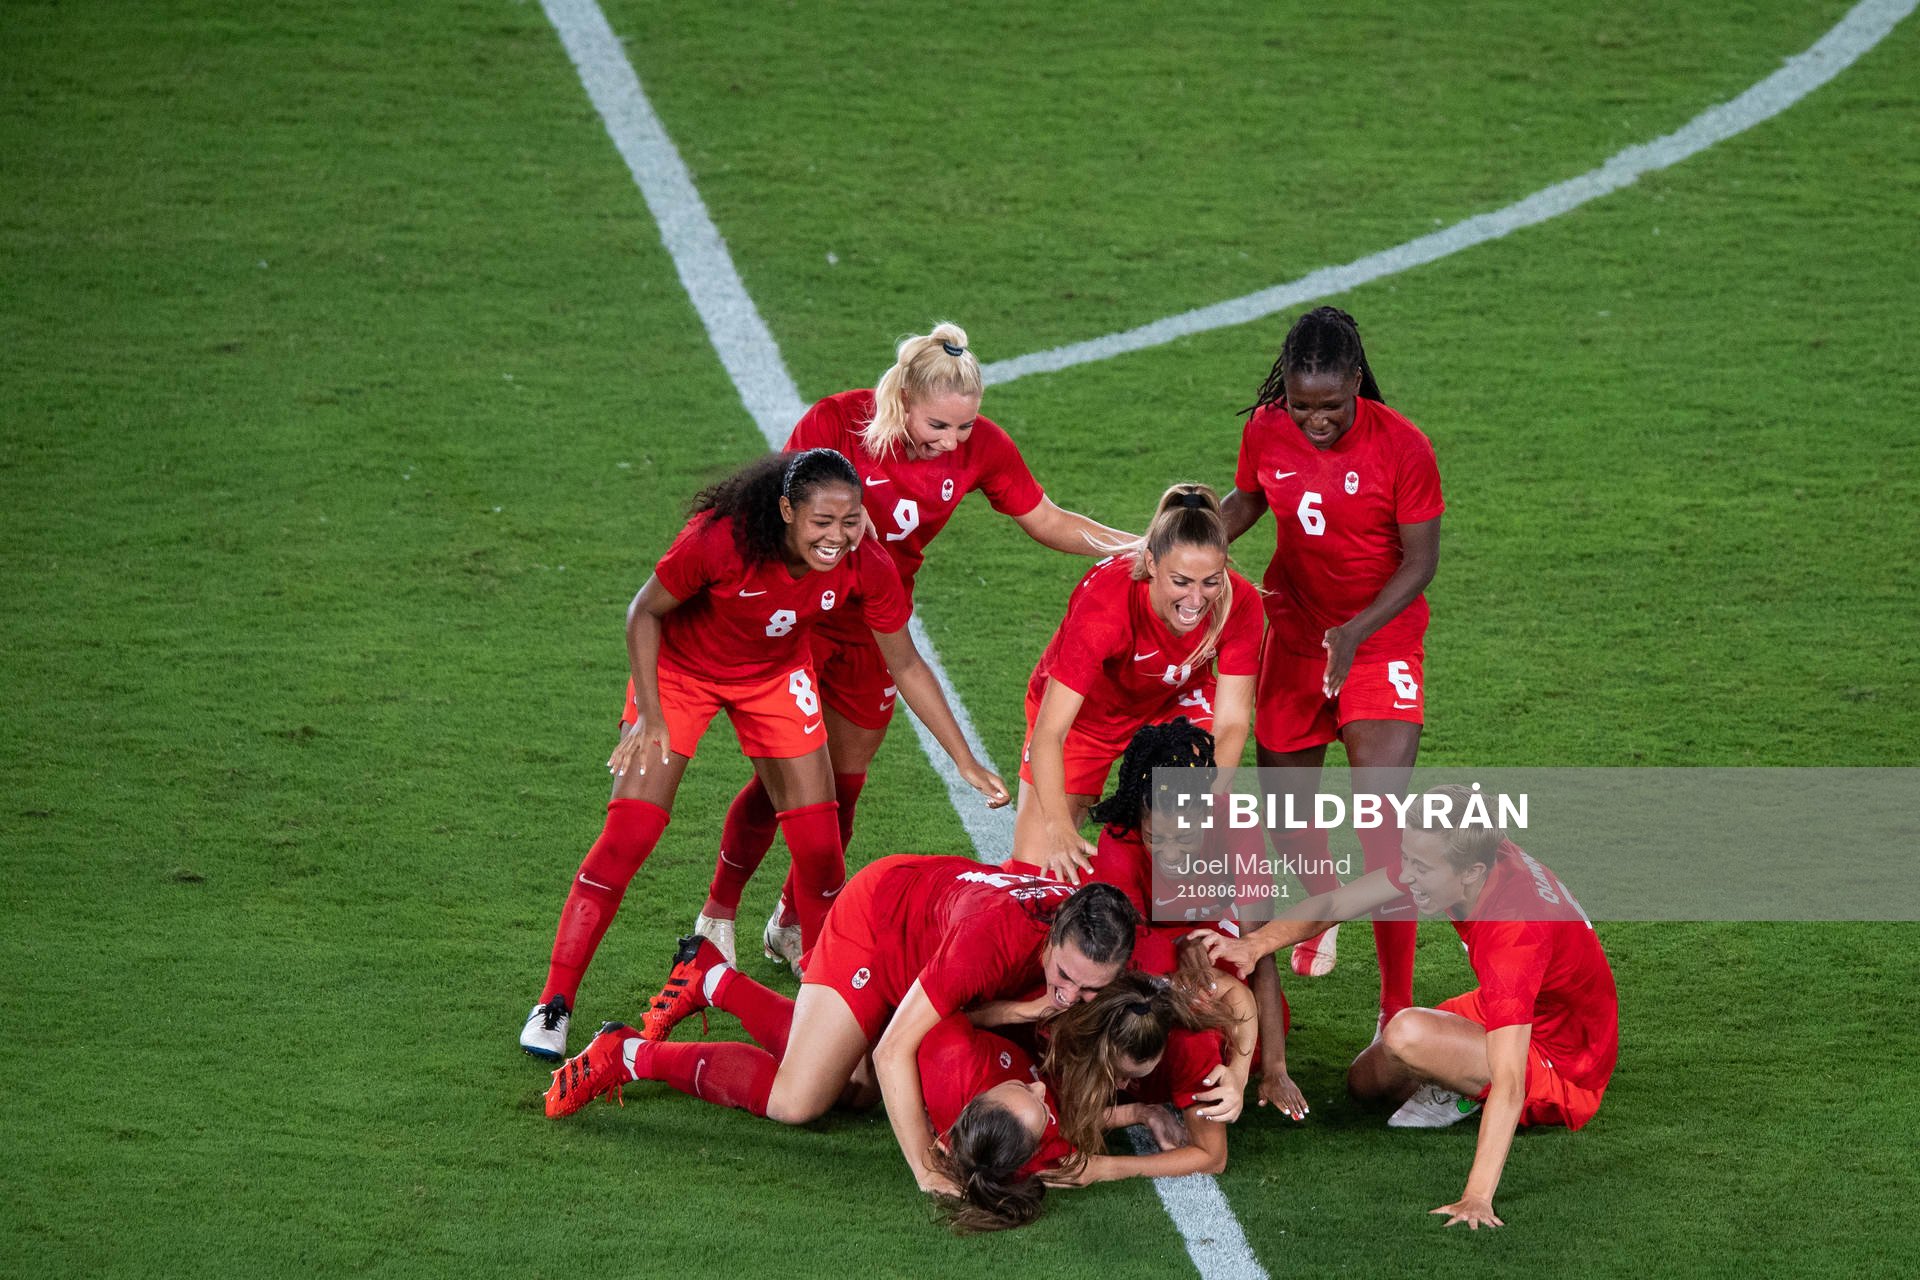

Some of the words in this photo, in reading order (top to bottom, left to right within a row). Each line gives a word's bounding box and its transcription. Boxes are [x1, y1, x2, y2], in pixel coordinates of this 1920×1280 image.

[886, 498, 920, 542] 9
[1297, 491, 1327, 536] 6
[765, 609, 797, 637] 8
[789, 669, 819, 717] 8
[1388, 660, 1419, 701] 6
